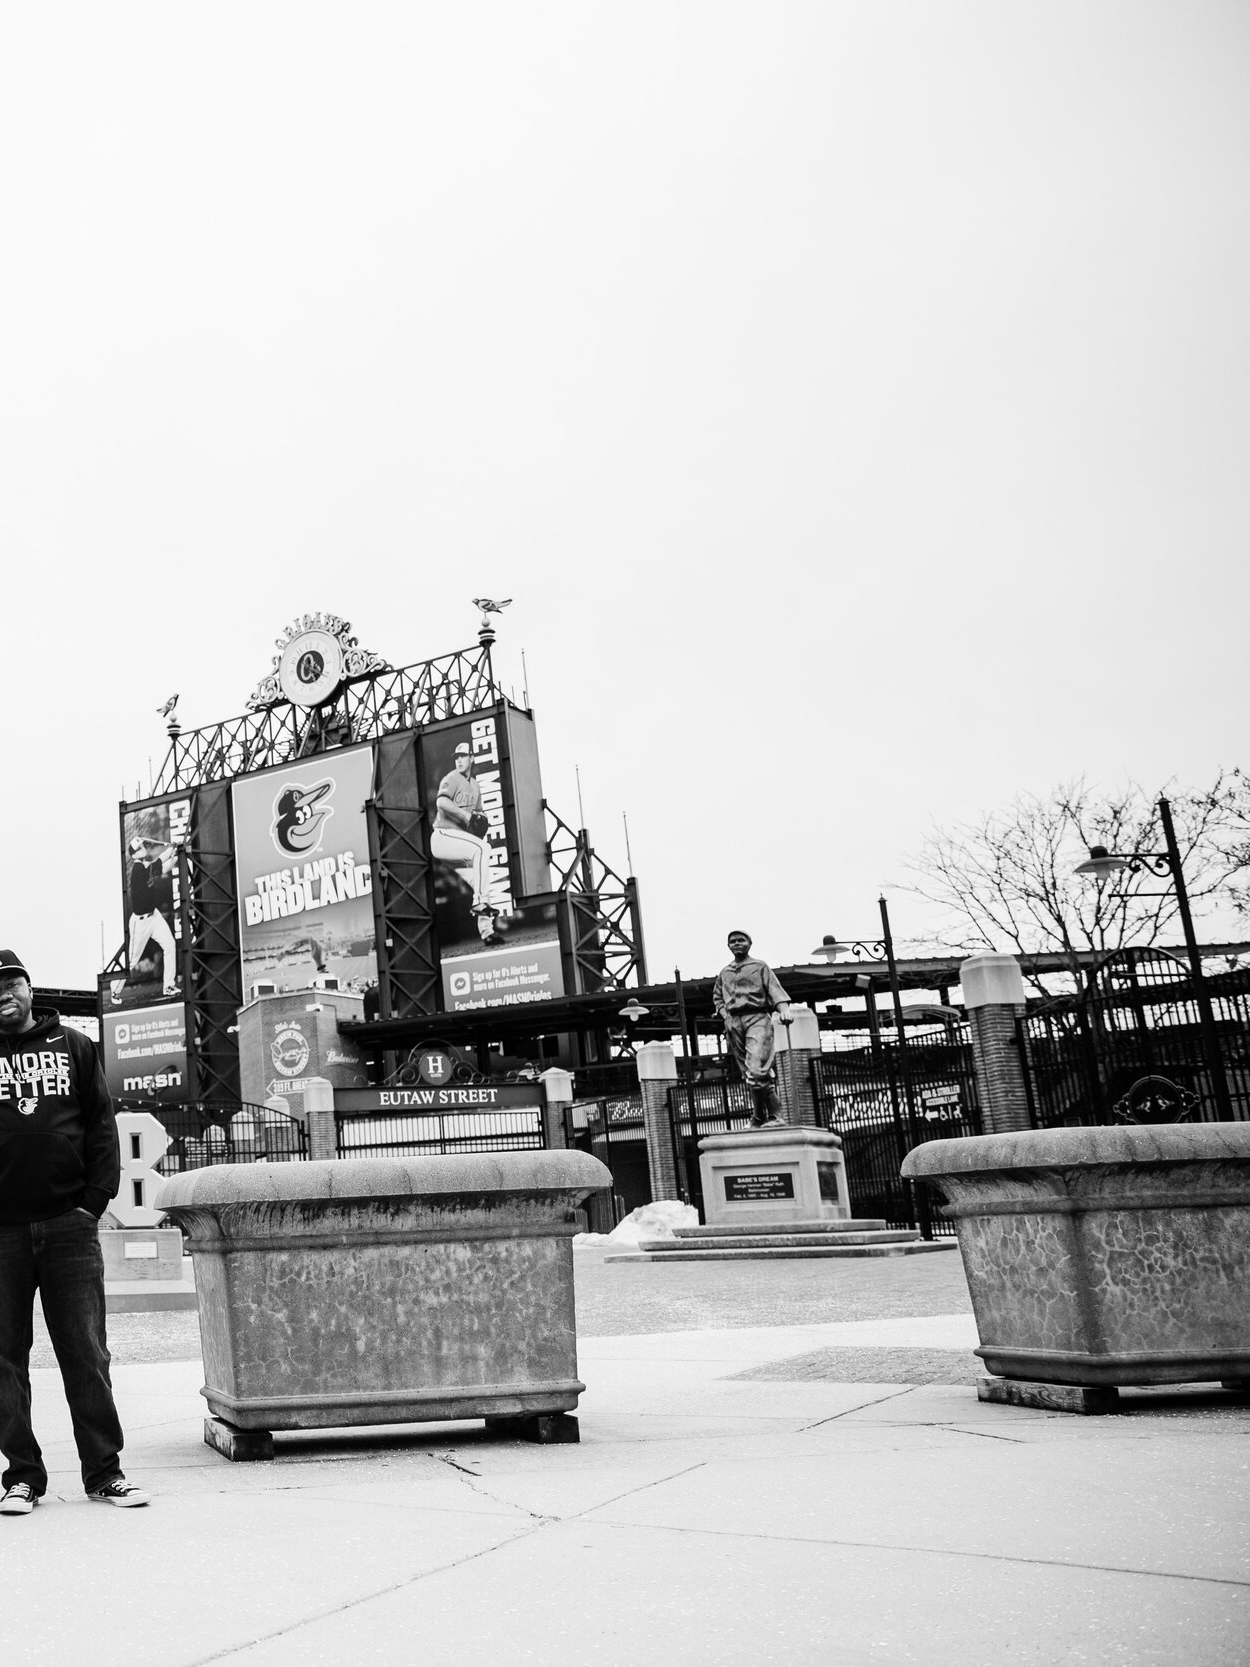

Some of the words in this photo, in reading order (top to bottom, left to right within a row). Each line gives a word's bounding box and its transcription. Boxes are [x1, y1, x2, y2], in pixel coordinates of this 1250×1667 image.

[471, 717, 499, 764] GET
[476, 769, 506, 845] MORE
[244, 864, 373, 926] BIRDLAND
[254, 869, 293, 895] THIS
[293, 857, 337, 883] LAND
[337, 851, 355, 872] IS
[488, 846, 514, 917] GAME
[124, 1072, 181, 1091] masn
[426, 1056, 444, 1074] H
[380, 1090, 436, 1106] EUTAW
[438, 1088, 498, 1104] STREET
